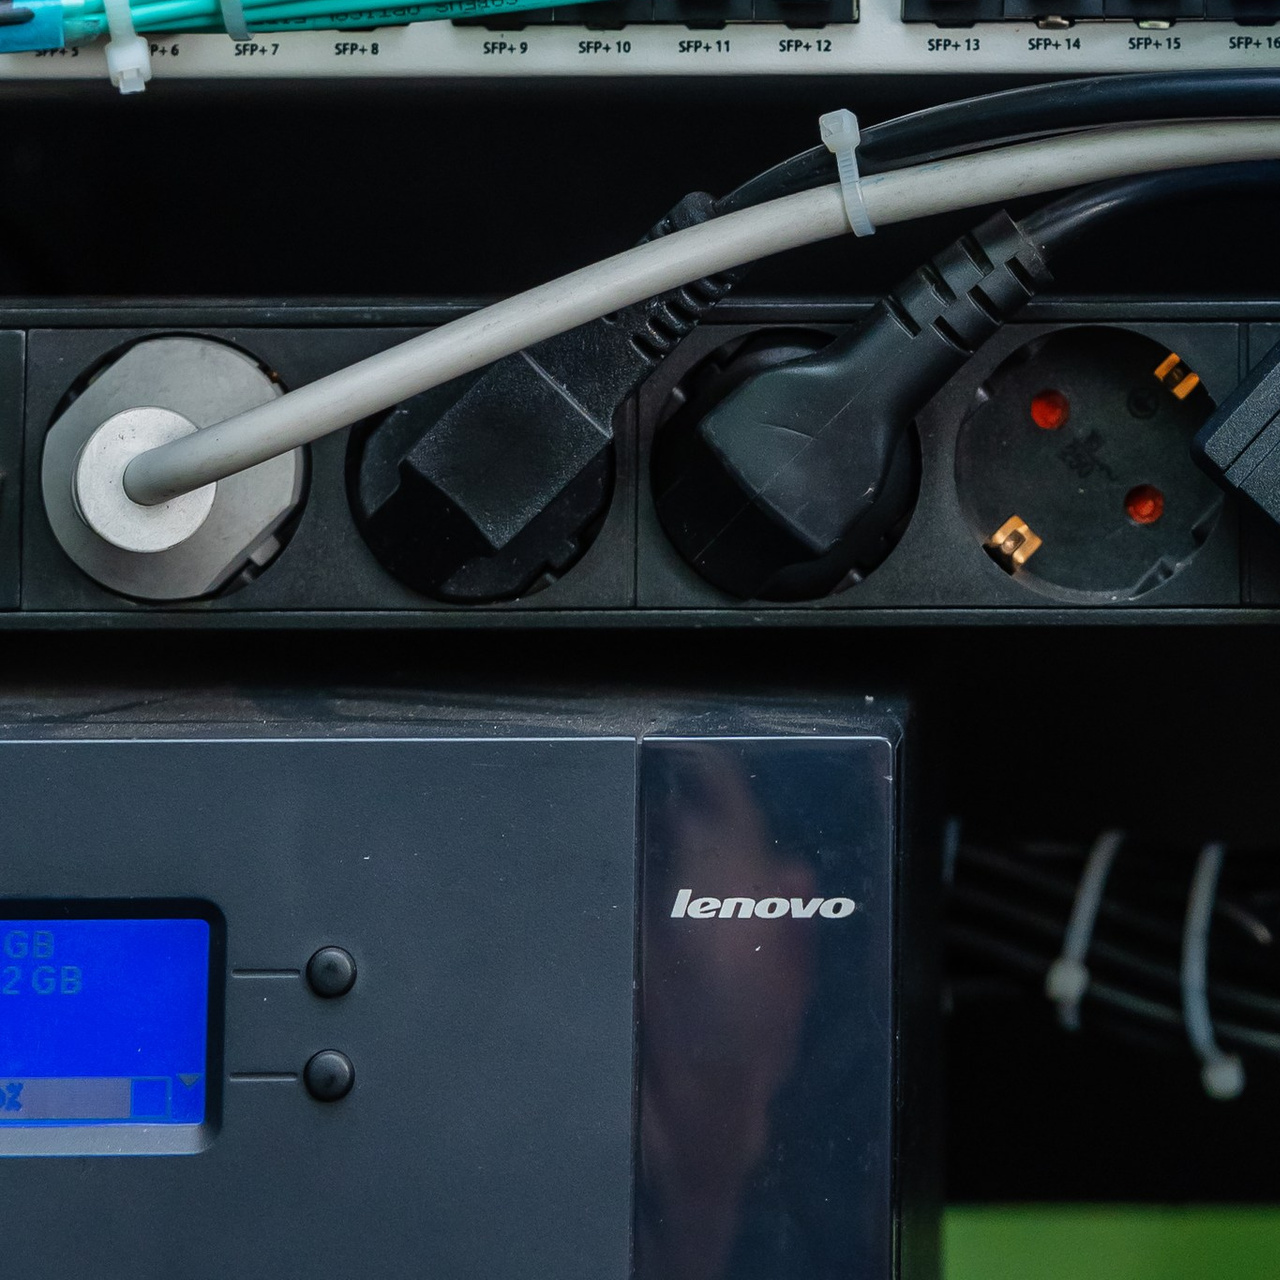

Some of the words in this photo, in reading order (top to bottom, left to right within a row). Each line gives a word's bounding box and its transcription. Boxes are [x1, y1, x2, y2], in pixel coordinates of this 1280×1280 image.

[170, 44, 179, 57] 6
[234, 42, 268, 56] SFP+
[271, 42, 279, 56] 7
[335, 42, 368, 56] SFP+
[371, 42, 379, 56] 8
[483, 42, 516, 55] SFP+
[519, 42, 528, 55] 9
[578, 41, 610, 55] SFP+
[613, 41, 631, 55] 10
[678, 40, 712, 54] SFP+
[716, 40, 731, 54] 11
[778, 40, 812, 54] SFP+
[815, 40, 832, 54] 12
[927, 38, 961, 53] SFP+
[964, 38, 981, 53] 13
[1028, 38, 1062, 52] SFP+
[1064, 38, 1081, 52] 14
[1128, 37, 1162, 51] SFP+
[1165, 37, 1181, 51] 15
[1228, 36, 1262, 51] SFP+
[669, 888, 856, 920] lenovo
[4, 929, 55, 960] GB
[32, 965, 83, 996] GB
